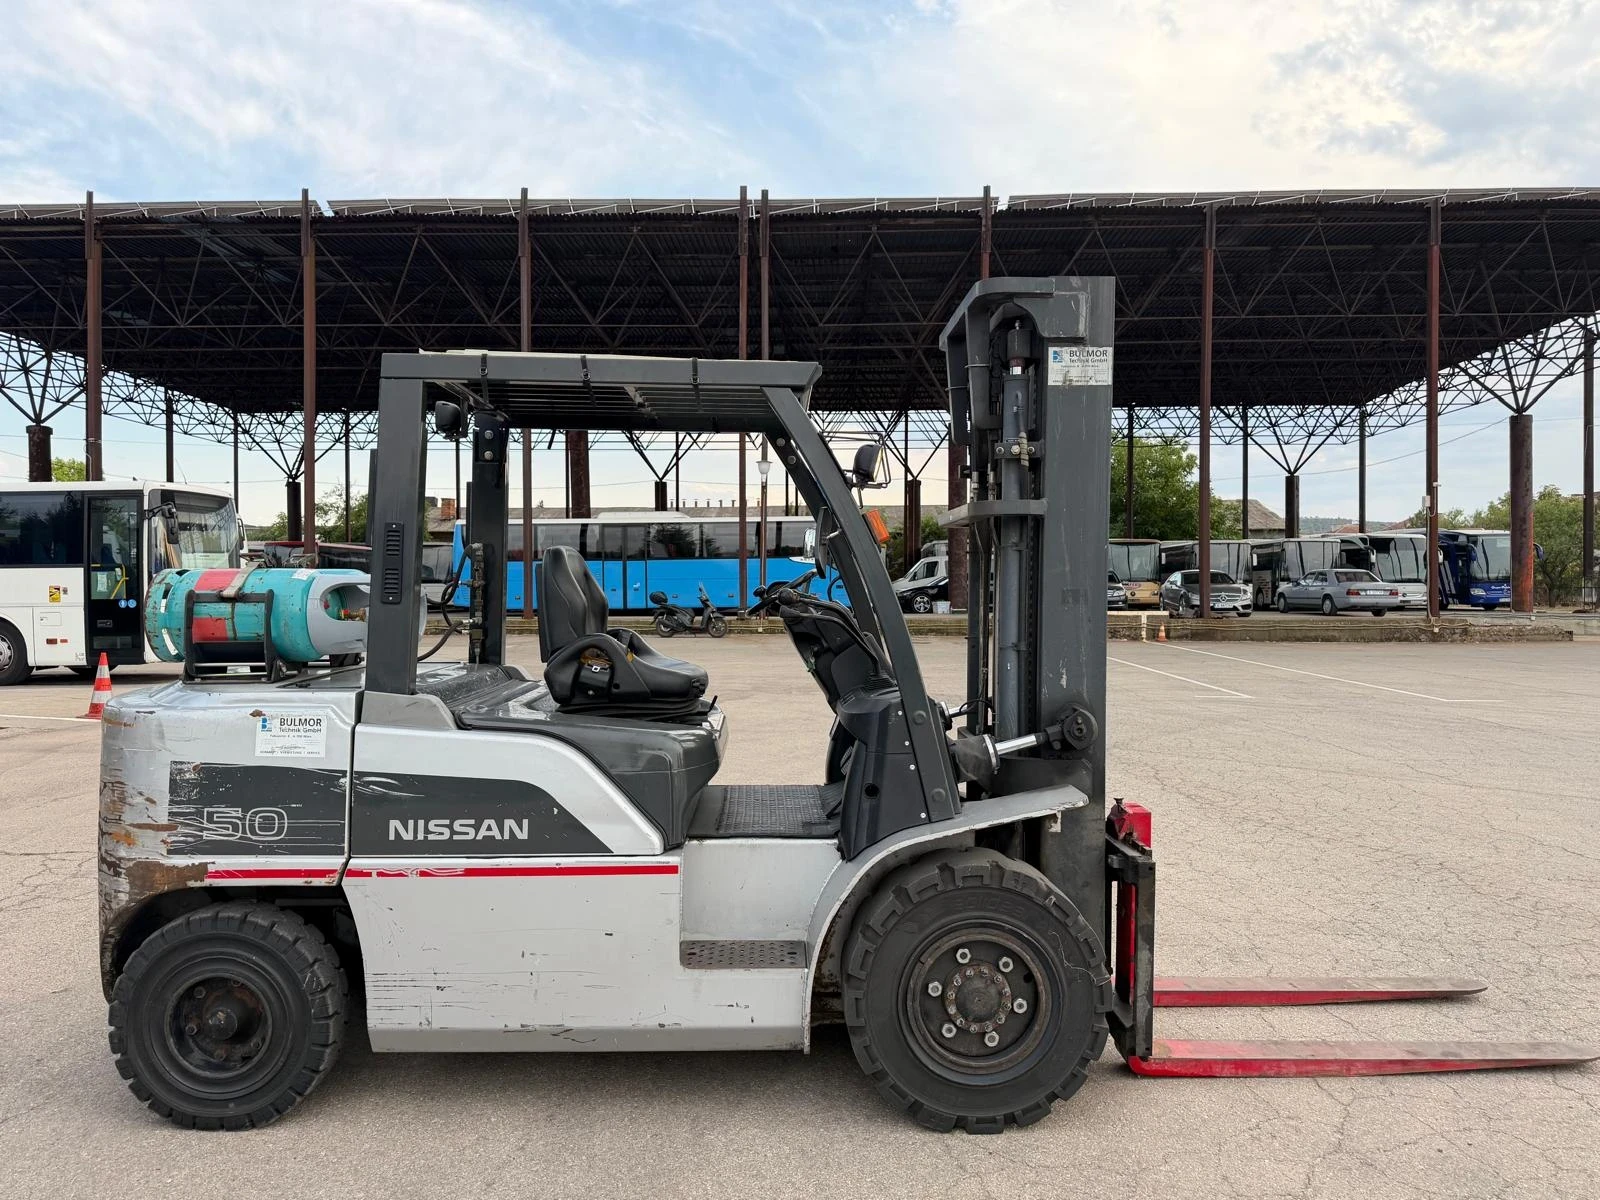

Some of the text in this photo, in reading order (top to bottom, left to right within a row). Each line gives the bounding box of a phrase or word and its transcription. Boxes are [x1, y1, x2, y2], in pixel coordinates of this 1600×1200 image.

[1069, 349, 1108, 358] BULMOR
[280, 717, 322, 727] BULMOR
[202, 807, 289, 841] 50
[388, 818, 529, 841] NISSAN
